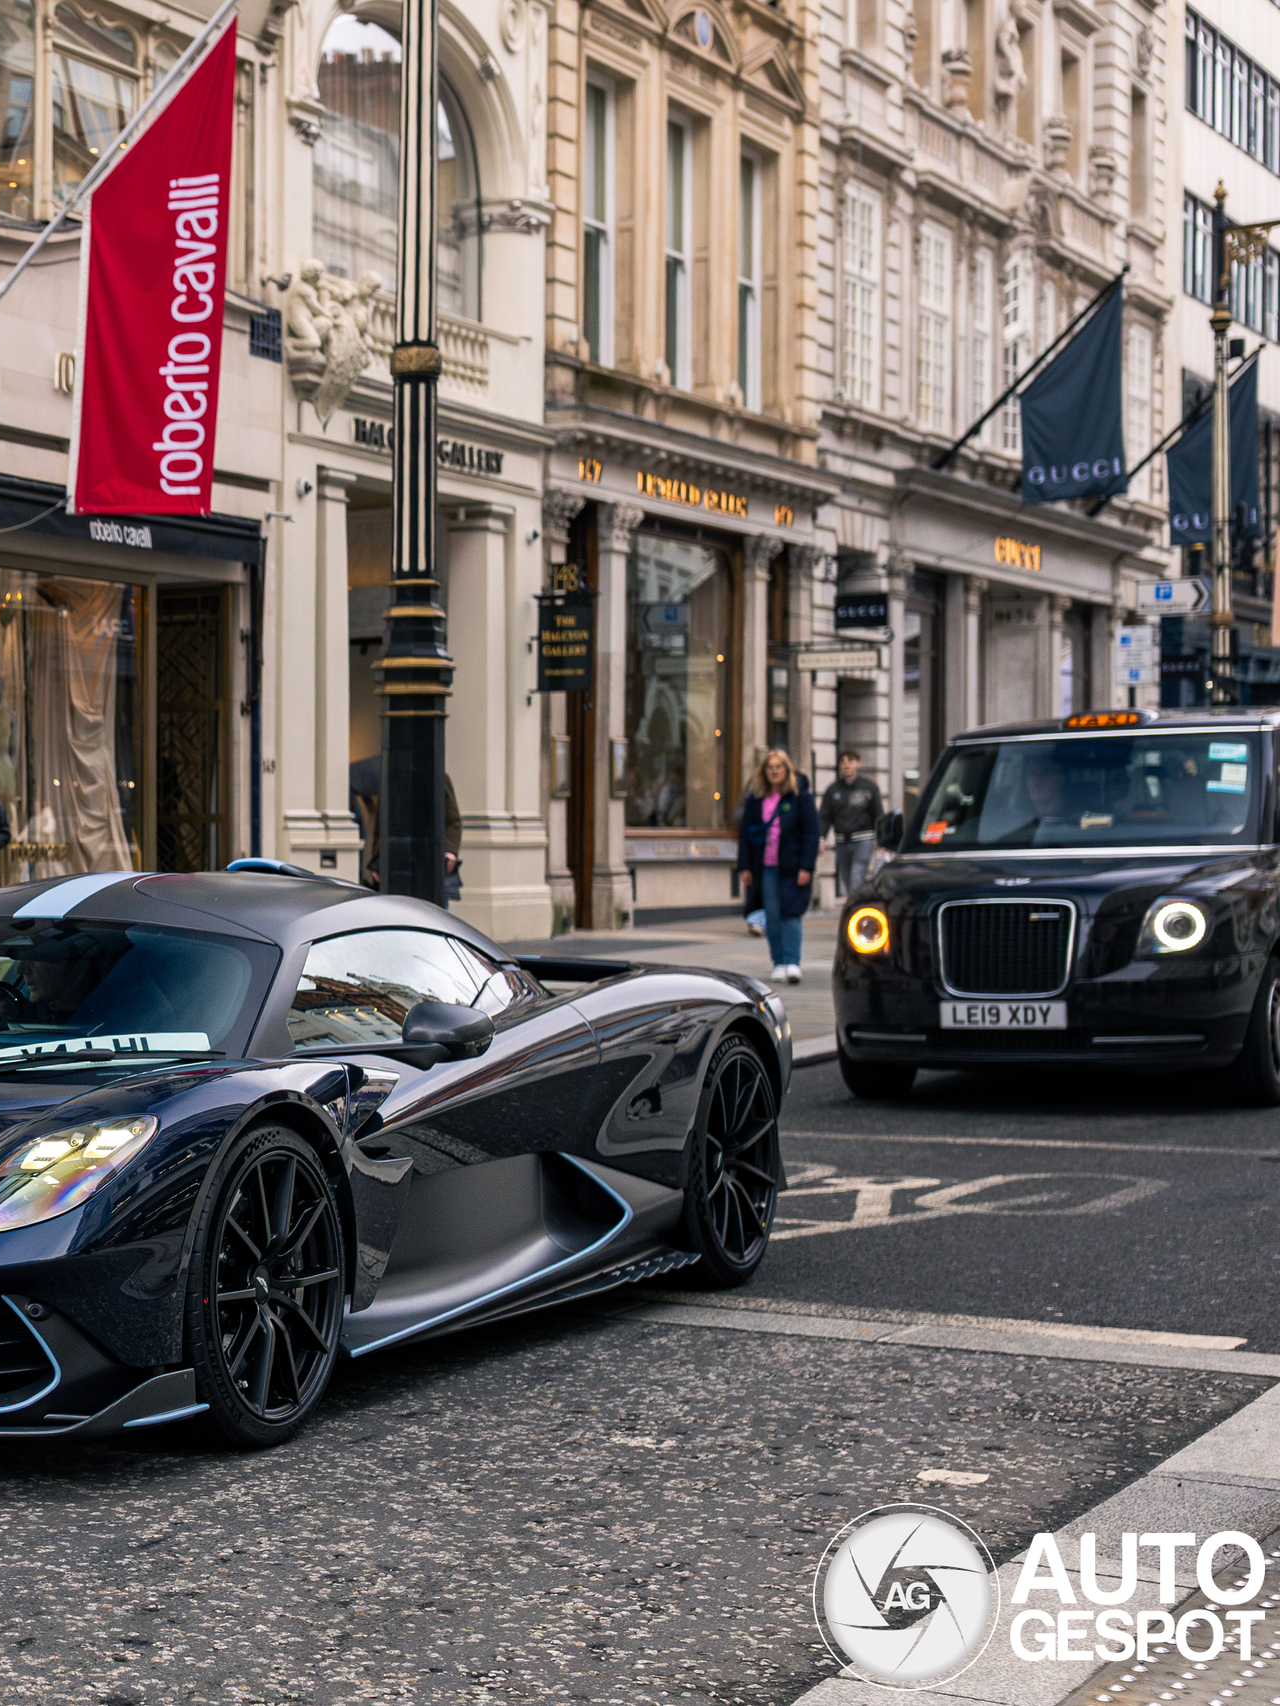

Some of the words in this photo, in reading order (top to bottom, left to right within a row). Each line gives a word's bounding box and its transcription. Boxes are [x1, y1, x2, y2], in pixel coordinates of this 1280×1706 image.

[168, 173, 220, 324] cavalli
[152, 332, 212, 496] roberto
[1028, 457, 1120, 485] GUCCI
[89, 518, 123, 544] roberto
[123, 525, 153, 550] cavalli
[1074, 713, 1131, 727] TAXI
[952, 1004, 1001, 1025] LE19
[1007, 1004, 1052, 1026] XDY
